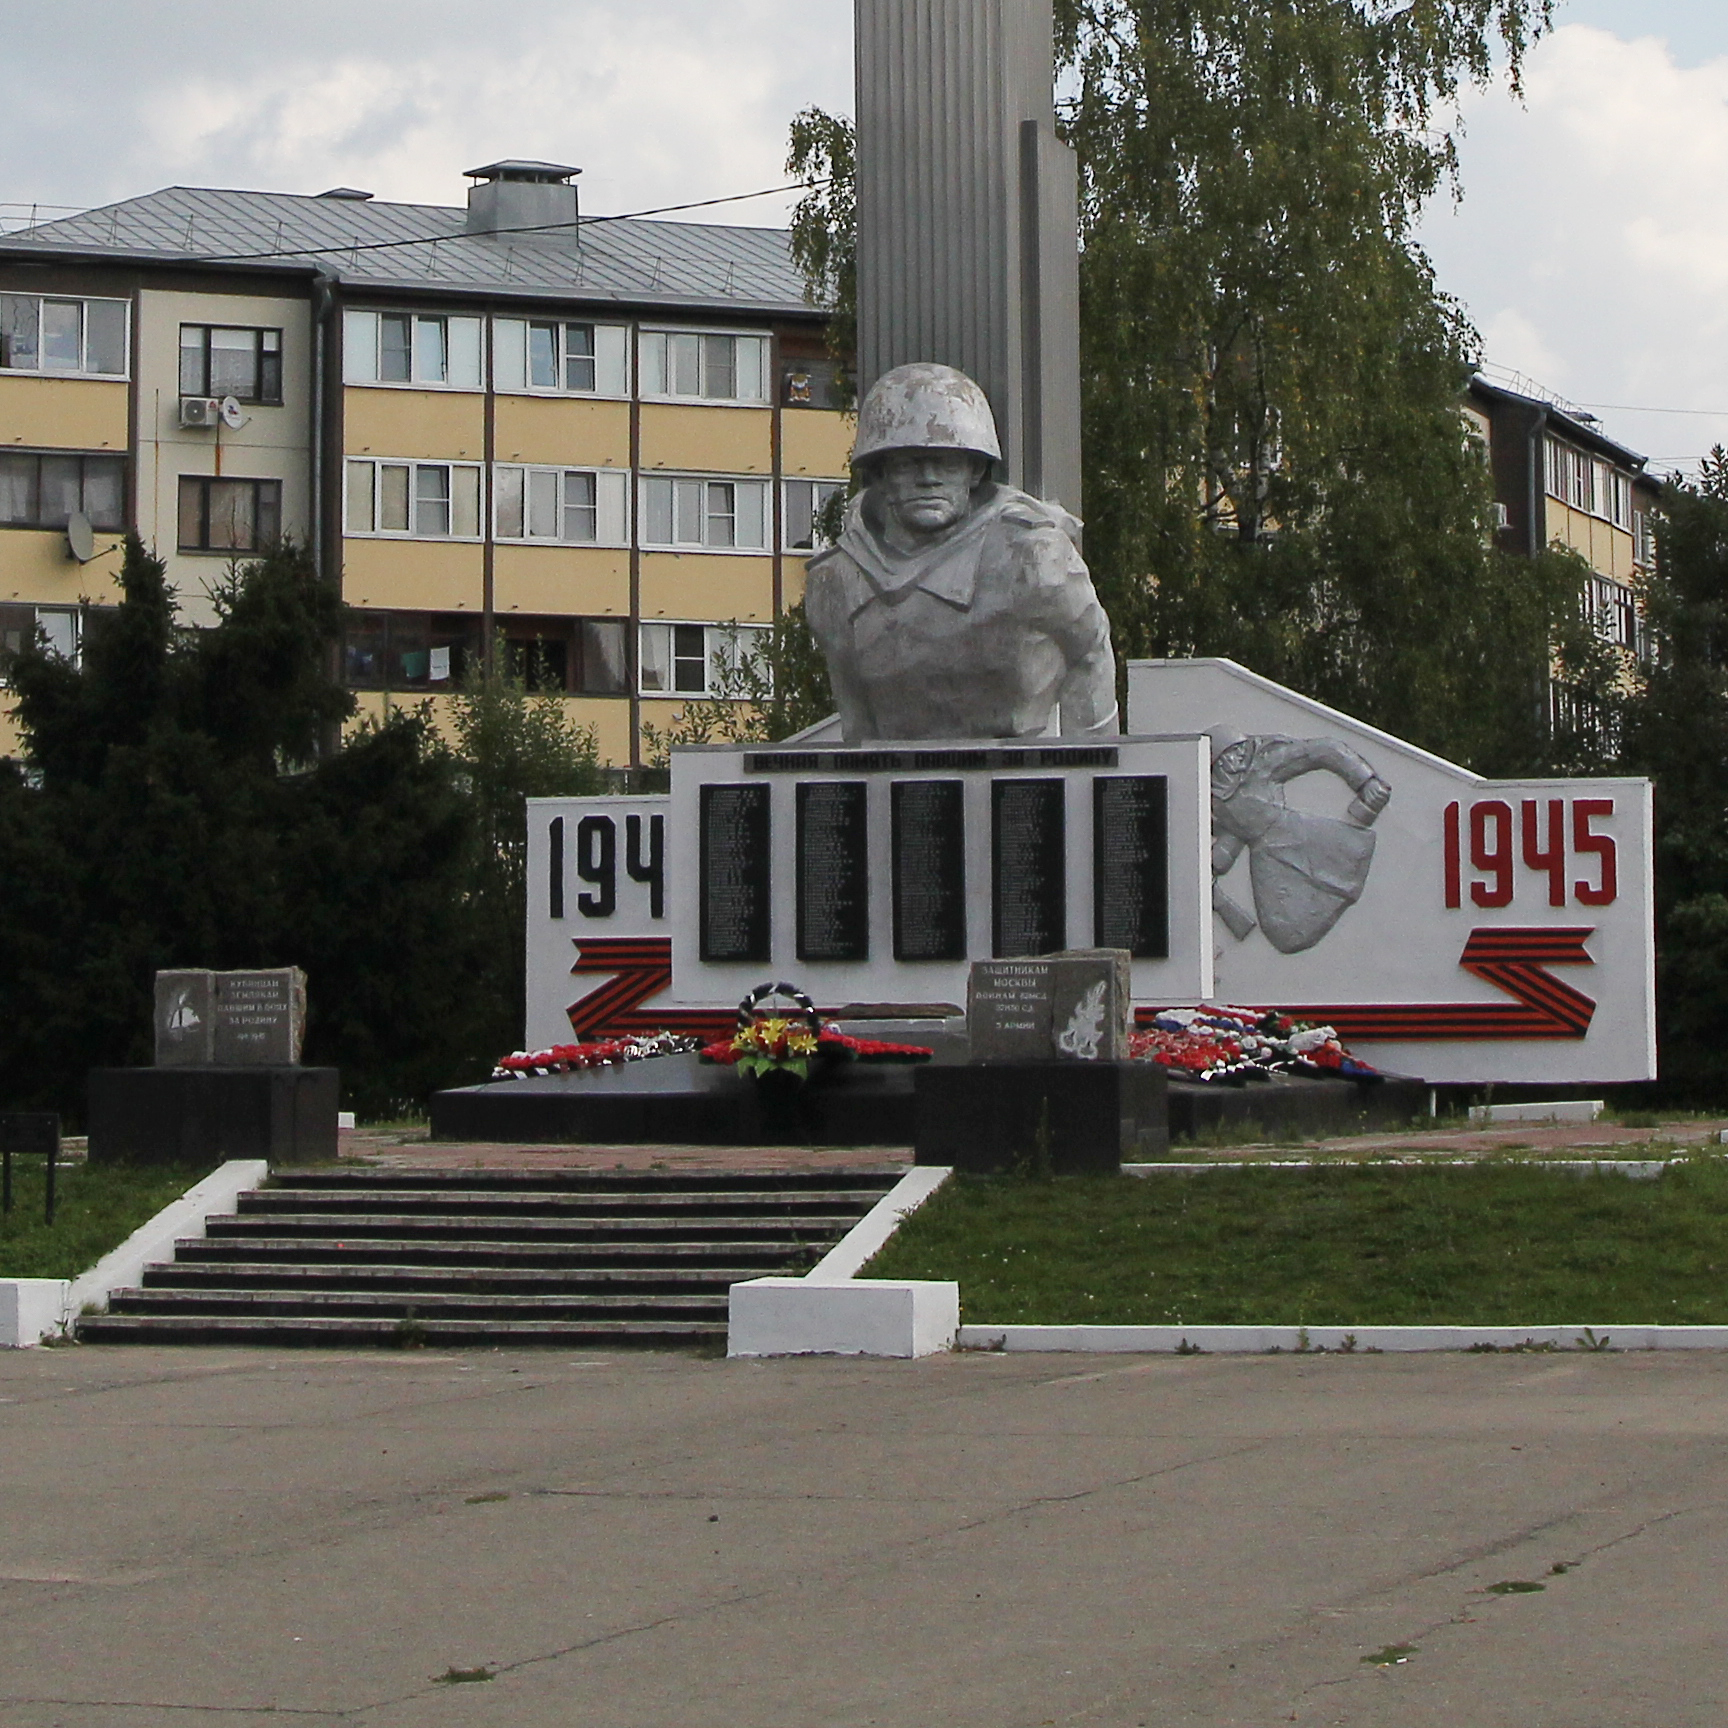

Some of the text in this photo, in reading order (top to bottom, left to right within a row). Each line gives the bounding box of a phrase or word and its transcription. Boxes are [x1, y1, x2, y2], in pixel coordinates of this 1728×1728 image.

[753, 747, 1112, 770] ВЕЧНАЯ ПАМЯТЬ ПАВШИМ ЗА РОДИНУ
[1443, 799, 1618, 909] 1945
[981, 965, 1049, 974] ЗАЩИТНИКАМ
[993, 978, 1037, 987] МОСКВЫ
